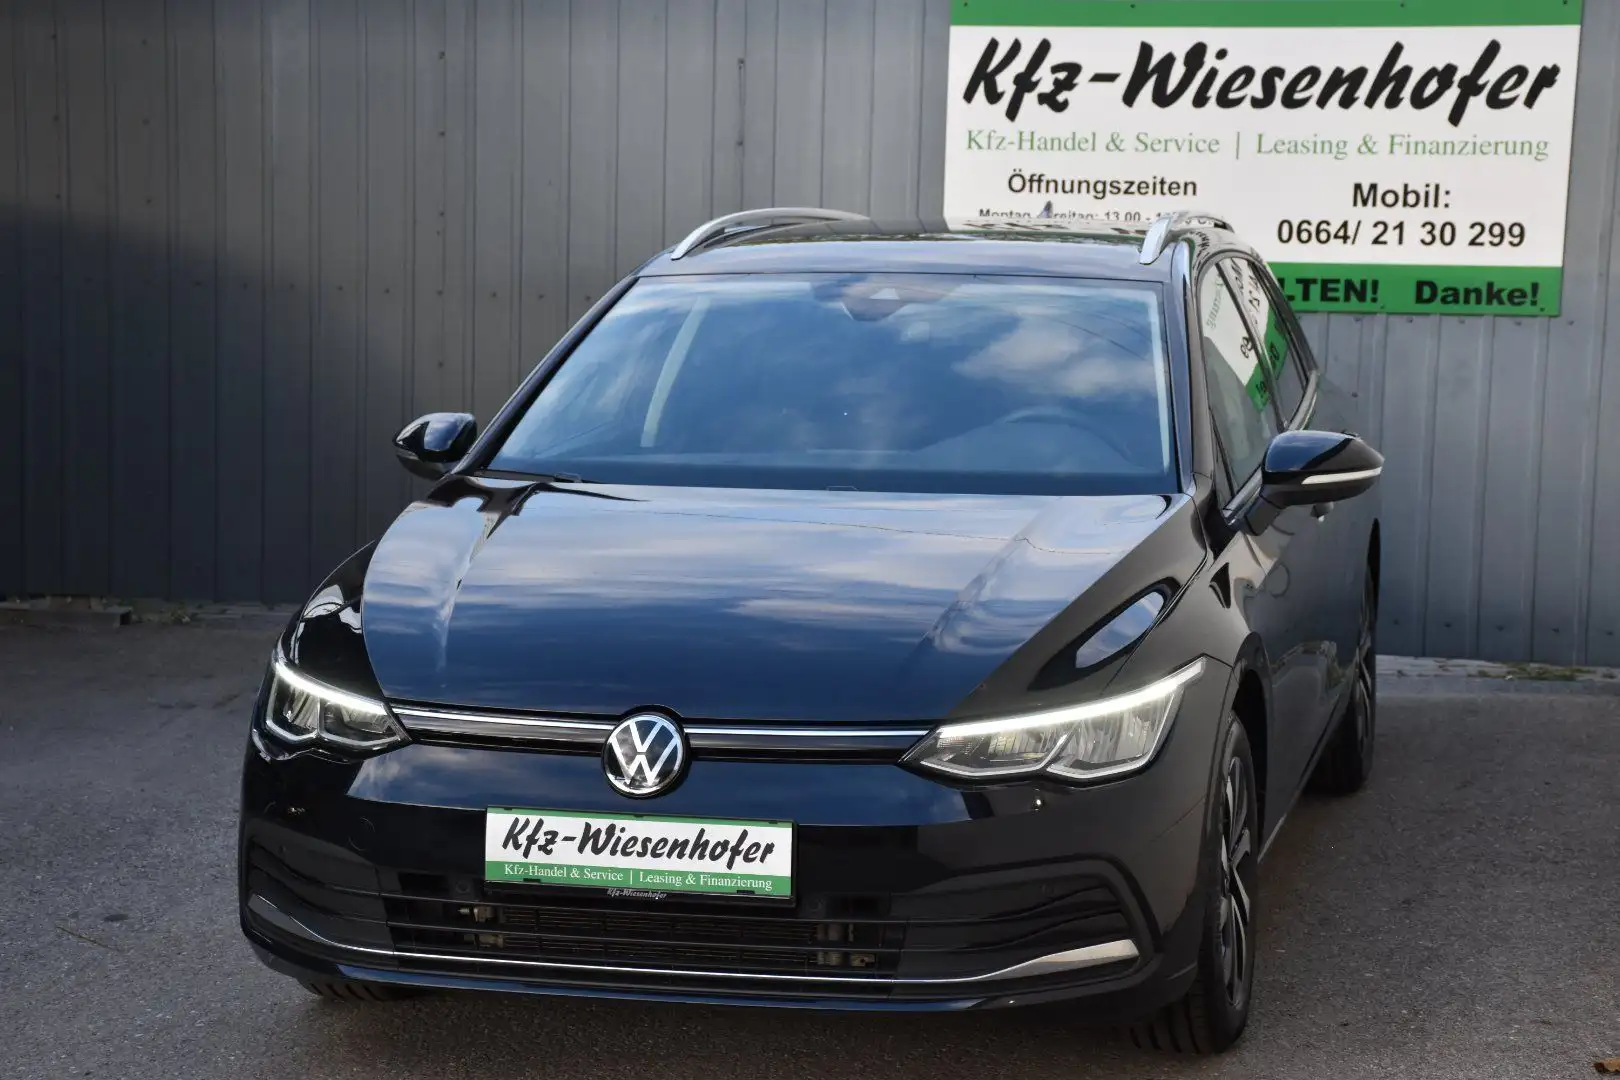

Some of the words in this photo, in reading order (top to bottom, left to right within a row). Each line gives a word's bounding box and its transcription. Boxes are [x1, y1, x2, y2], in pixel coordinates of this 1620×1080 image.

[963, 38, 1561, 127] Kfz-Wiesenhofer
[967, 129, 1097, 151] Kfz-Handel
[1105, 131, 1126, 152] &
[1134, 132, 1220, 153] Service
[1256, 133, 1348, 160] Leasing
[1356, 134, 1378, 155] &
[1388, 133, 1549, 162] Finanzierung
[1008, 168, 1197, 199] Öffnungszeiten
[1352, 183, 1451, 208] Mobil:
[1277, 219, 1361, 245] 0664/
[1371, 220, 1405, 245] 21
[1420, 221, 1456, 246] 30
[1468, 221, 1526, 247] 299
[1415, 280, 1539, 306] Danke!
[501, 816, 774, 870] Kfz-Wiesenhofer
[504, 864, 567, 879] Kfz-Handel
[570, 864, 580, 878] &
[583, 868, 624, 881] Service
[639, 871, 682, 886] Leasing
[685, 872, 696, 885] &
[700, 875, 772, 891] Finanzierung
